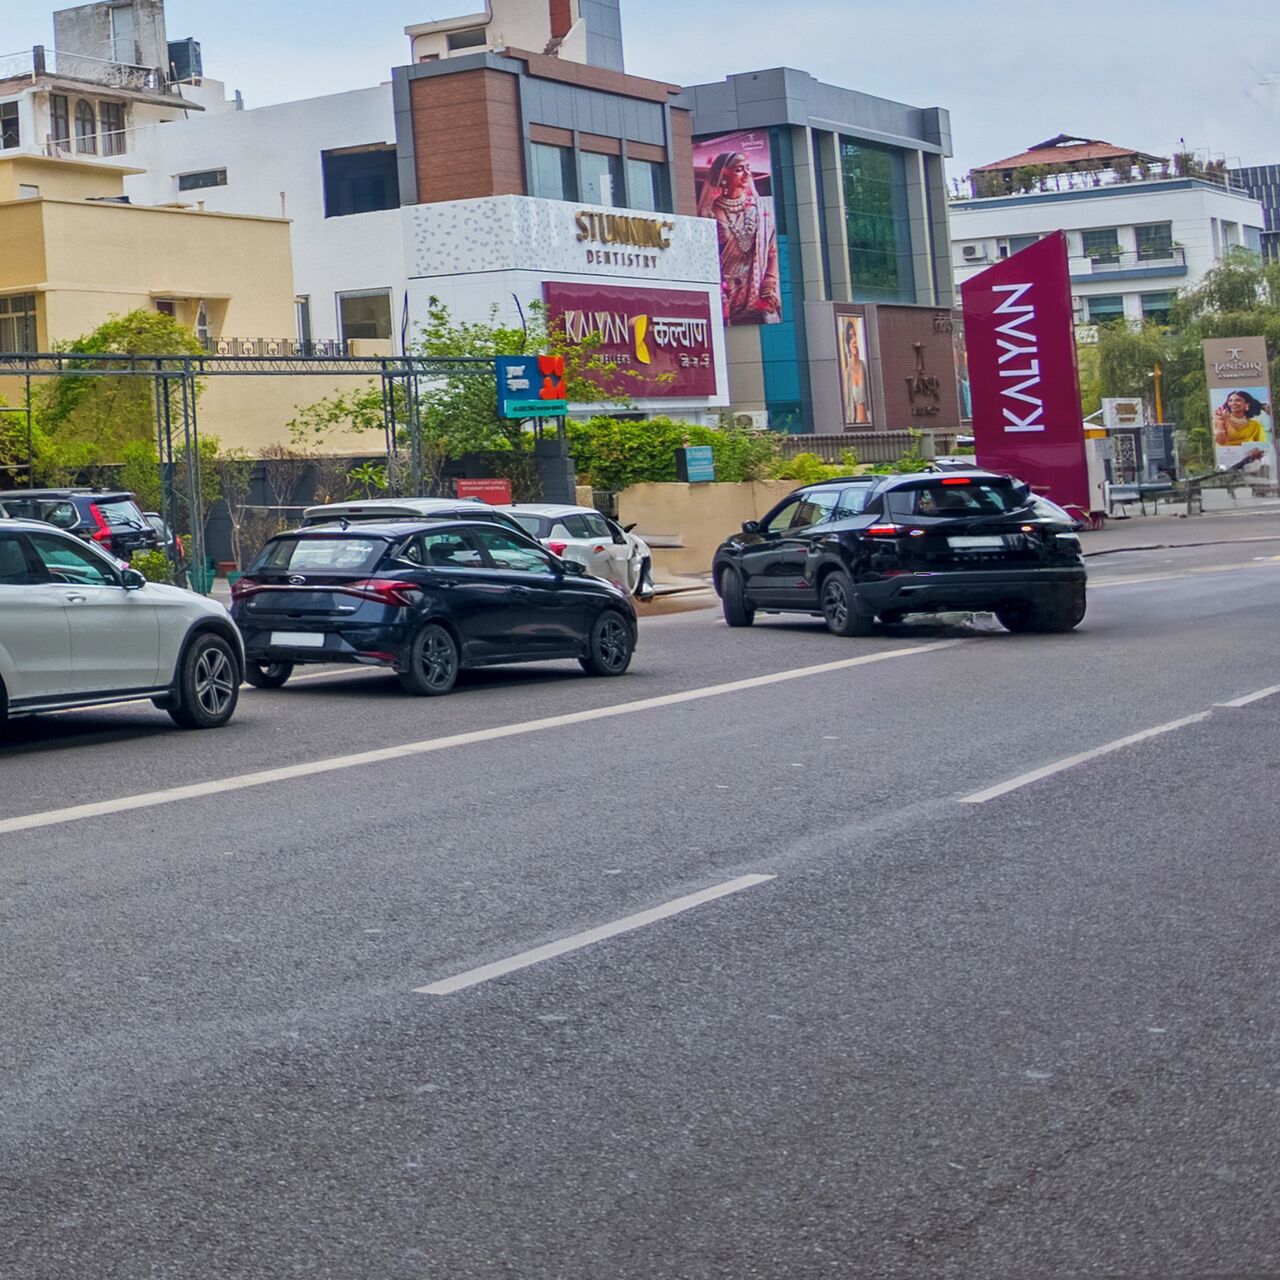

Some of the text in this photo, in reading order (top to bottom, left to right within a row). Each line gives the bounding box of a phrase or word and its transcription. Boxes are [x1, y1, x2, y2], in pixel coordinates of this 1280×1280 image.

[586, 249, 658, 269] DENTISTRY
[565, 310, 630, 345] KALYAN
[991, 282, 1045, 433] KALYAN
